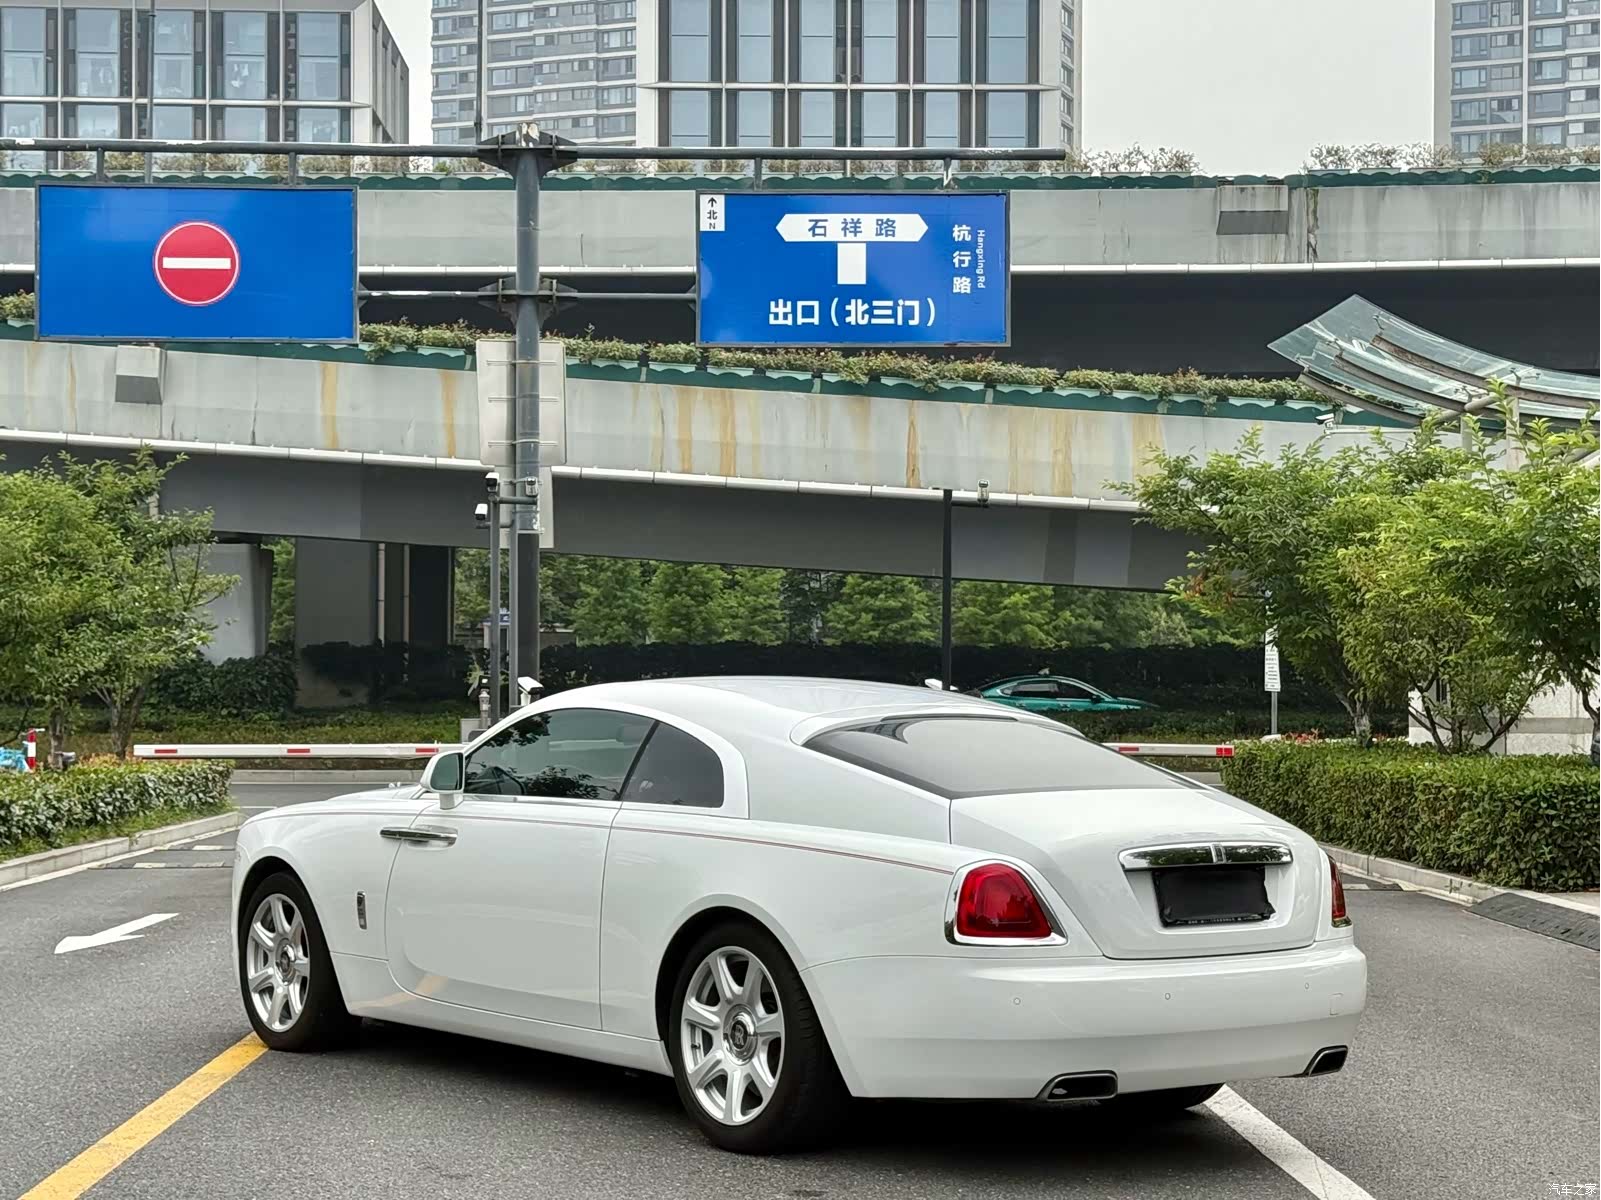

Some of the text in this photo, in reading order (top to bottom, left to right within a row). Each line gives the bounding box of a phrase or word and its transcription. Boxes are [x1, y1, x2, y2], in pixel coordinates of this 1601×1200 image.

[706, 209, 718, 220] 北
[709, 222, 716, 230] N
[808, 218, 896, 238] 石祥路
[952, 224, 971, 294] 杭行路
[976, 229, 986, 289] Hangxing Rd
